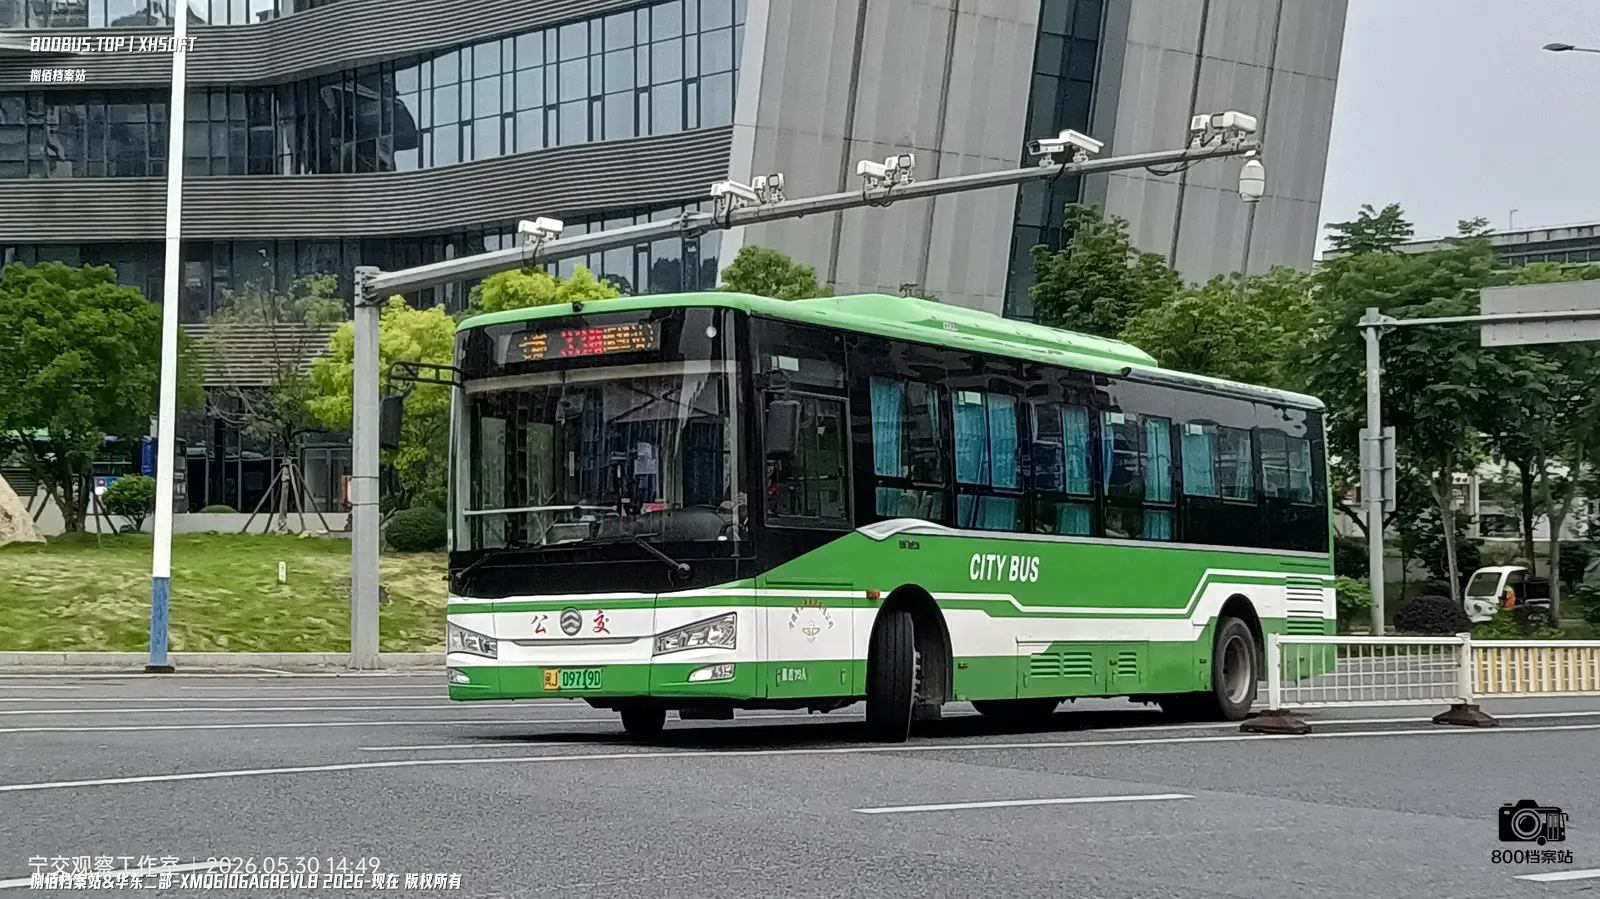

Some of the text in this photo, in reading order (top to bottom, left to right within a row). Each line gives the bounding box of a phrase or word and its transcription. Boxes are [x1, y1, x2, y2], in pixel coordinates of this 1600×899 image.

[969, 553, 1040, 583] CITY BUS
[531, 610, 611, 635] 公 交
